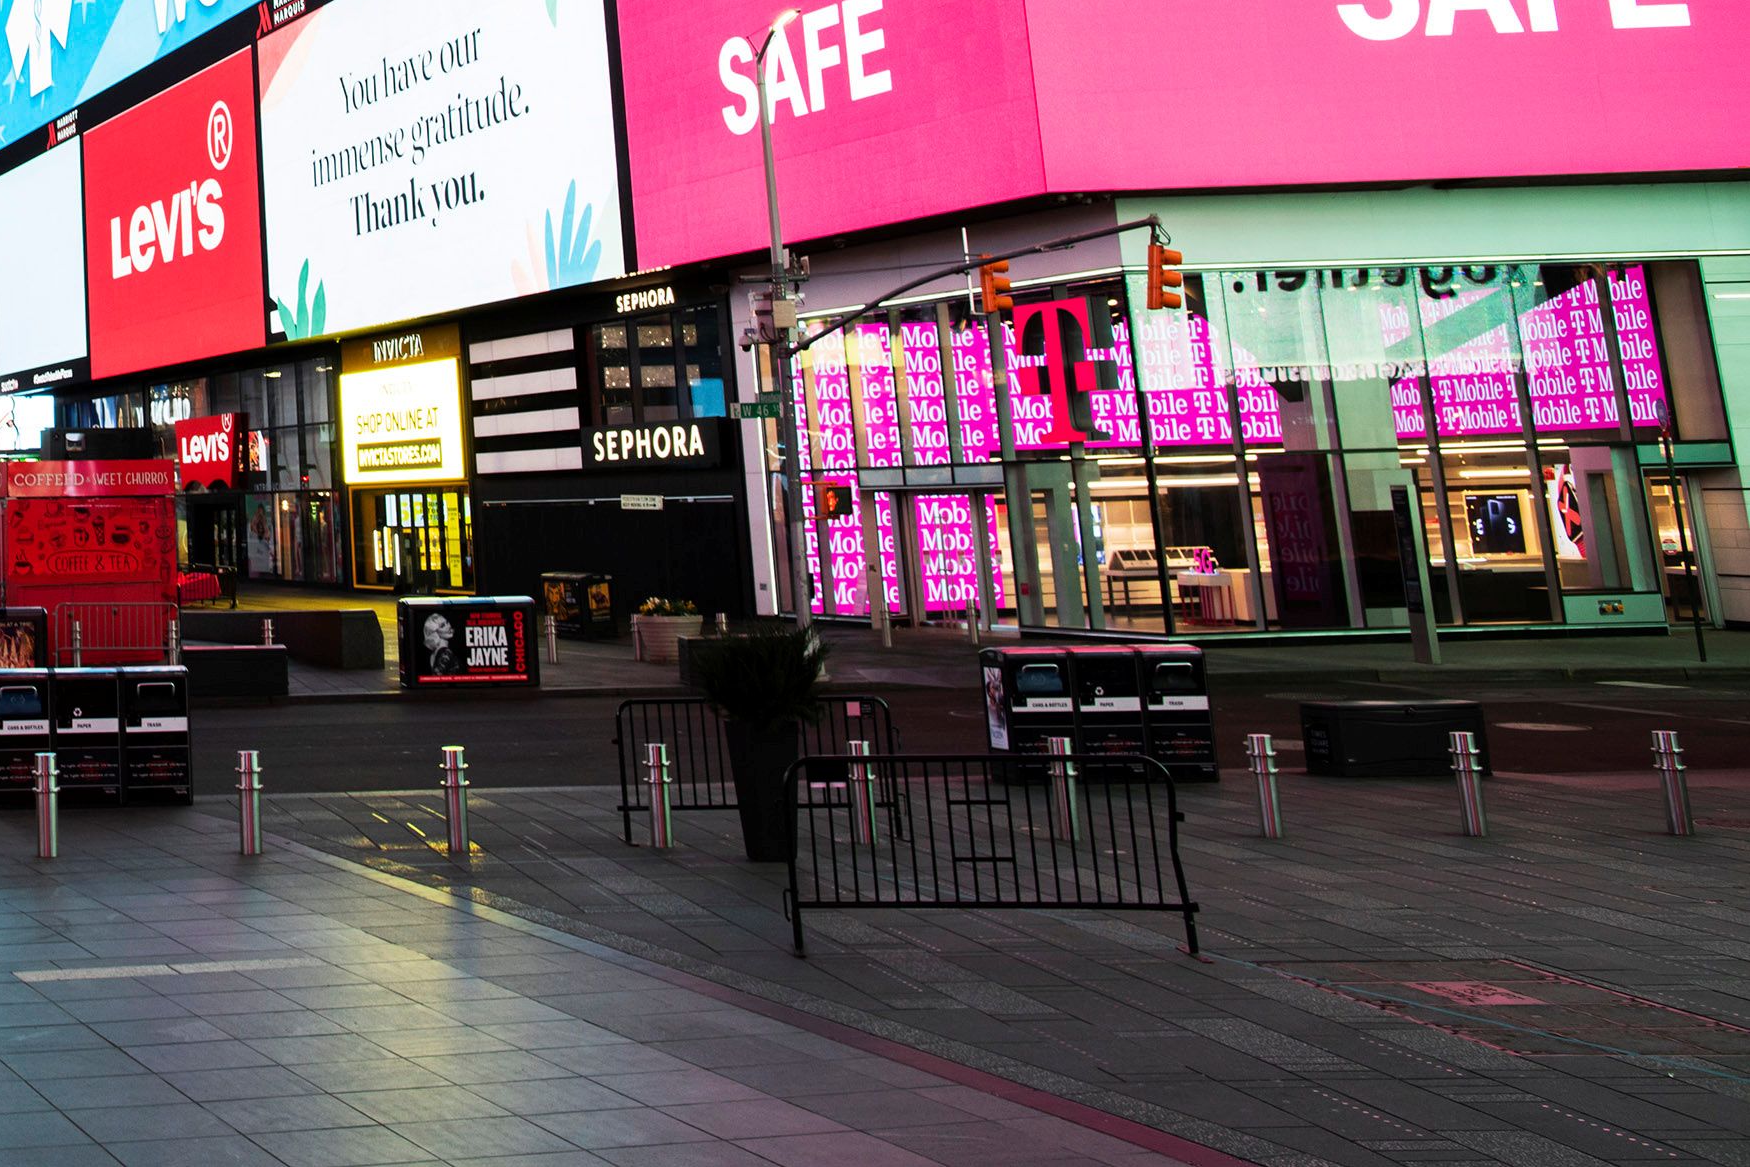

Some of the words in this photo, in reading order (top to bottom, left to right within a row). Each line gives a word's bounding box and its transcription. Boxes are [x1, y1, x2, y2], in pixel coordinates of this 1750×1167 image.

[338, 69, 382, 116] You
[392, 49, 434, 97] have
[438, 26, 482, 74] our
[56, 109, 79, 133] MARRIOTT
[311, 126, 405, 188] immense
[409, 76, 531, 166] gratitude.
[349, 177, 428, 238] Thank
[429, 170, 485, 226] you.
[615, 286, 675, 313] SEPHORA
[372, 333, 425, 364] INVICTA
[1454, 380, 1504, 403] Mobile
[356, 413, 383, 435] SHOP
[385, 408, 423, 432] ONLINE
[426, 406, 439, 428] AT
[741, 404, 752, 417] W
[756, 404, 769, 417] 46
[1458, 405, 1508, 429] Mobile
[357, 443, 441, 468] INVICTASTORES.COM
[592, 424, 705, 463] SEPHORA
[91, 471, 123, 487] SWEET
[125, 470, 169, 486] CHURROS
[54, 557, 92, 573] COFFEE
[110, 555, 132, 573] TEA
[1191, 547, 1214, 575] 5G
[465, 626, 508, 647] ERIKA
[513, 610, 526, 672] CHICAGO
[466, 647, 509, 667] JAYNE
